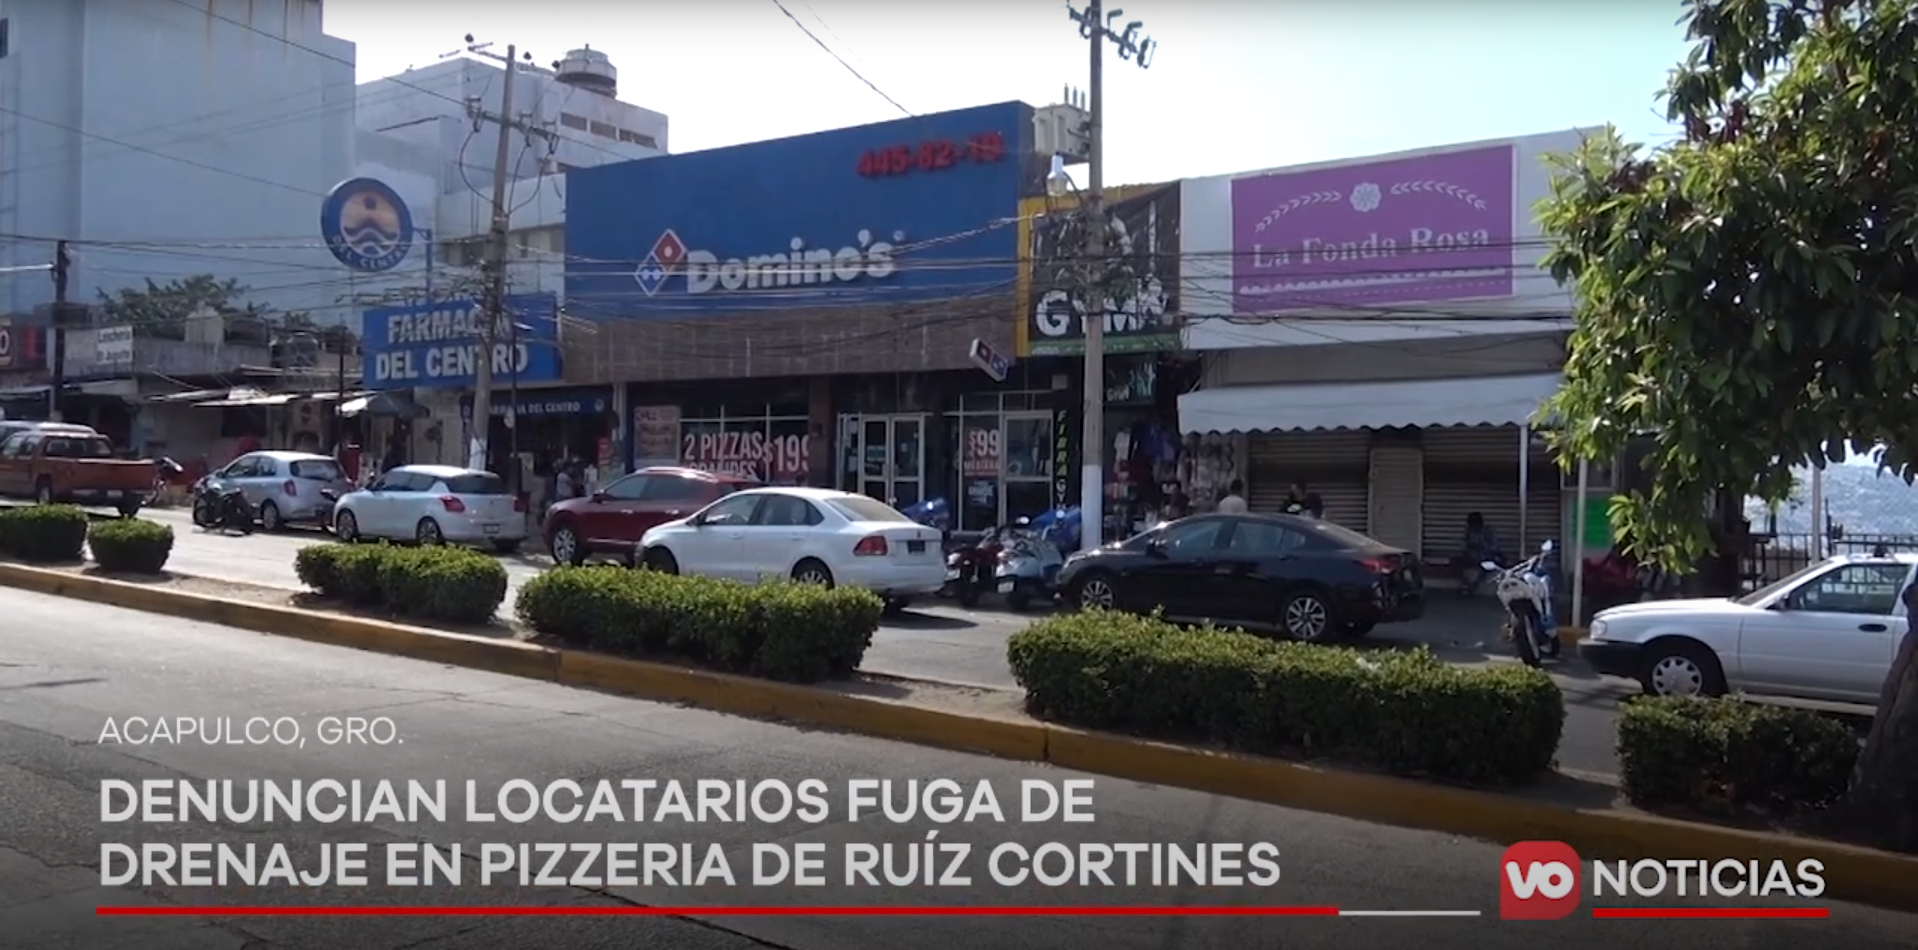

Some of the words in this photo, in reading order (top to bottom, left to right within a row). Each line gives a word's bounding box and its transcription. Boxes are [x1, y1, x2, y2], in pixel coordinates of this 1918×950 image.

[687, 229, 896, 293] Domino's
[1253, 244, 1290, 268] La
[1302, 233, 1396, 265] Fonda
[1410, 227, 1489, 253] Rosa
[376, 352, 418, 380] DEL
[426, 344, 528, 377] CENRO
[528, 403, 543, 414] DEL
[545, 401, 581, 414] CENTRO
[684, 434, 695, 460] 2
[701, 431, 763, 461] PIZZAS
[968, 429, 999, 456] $99
